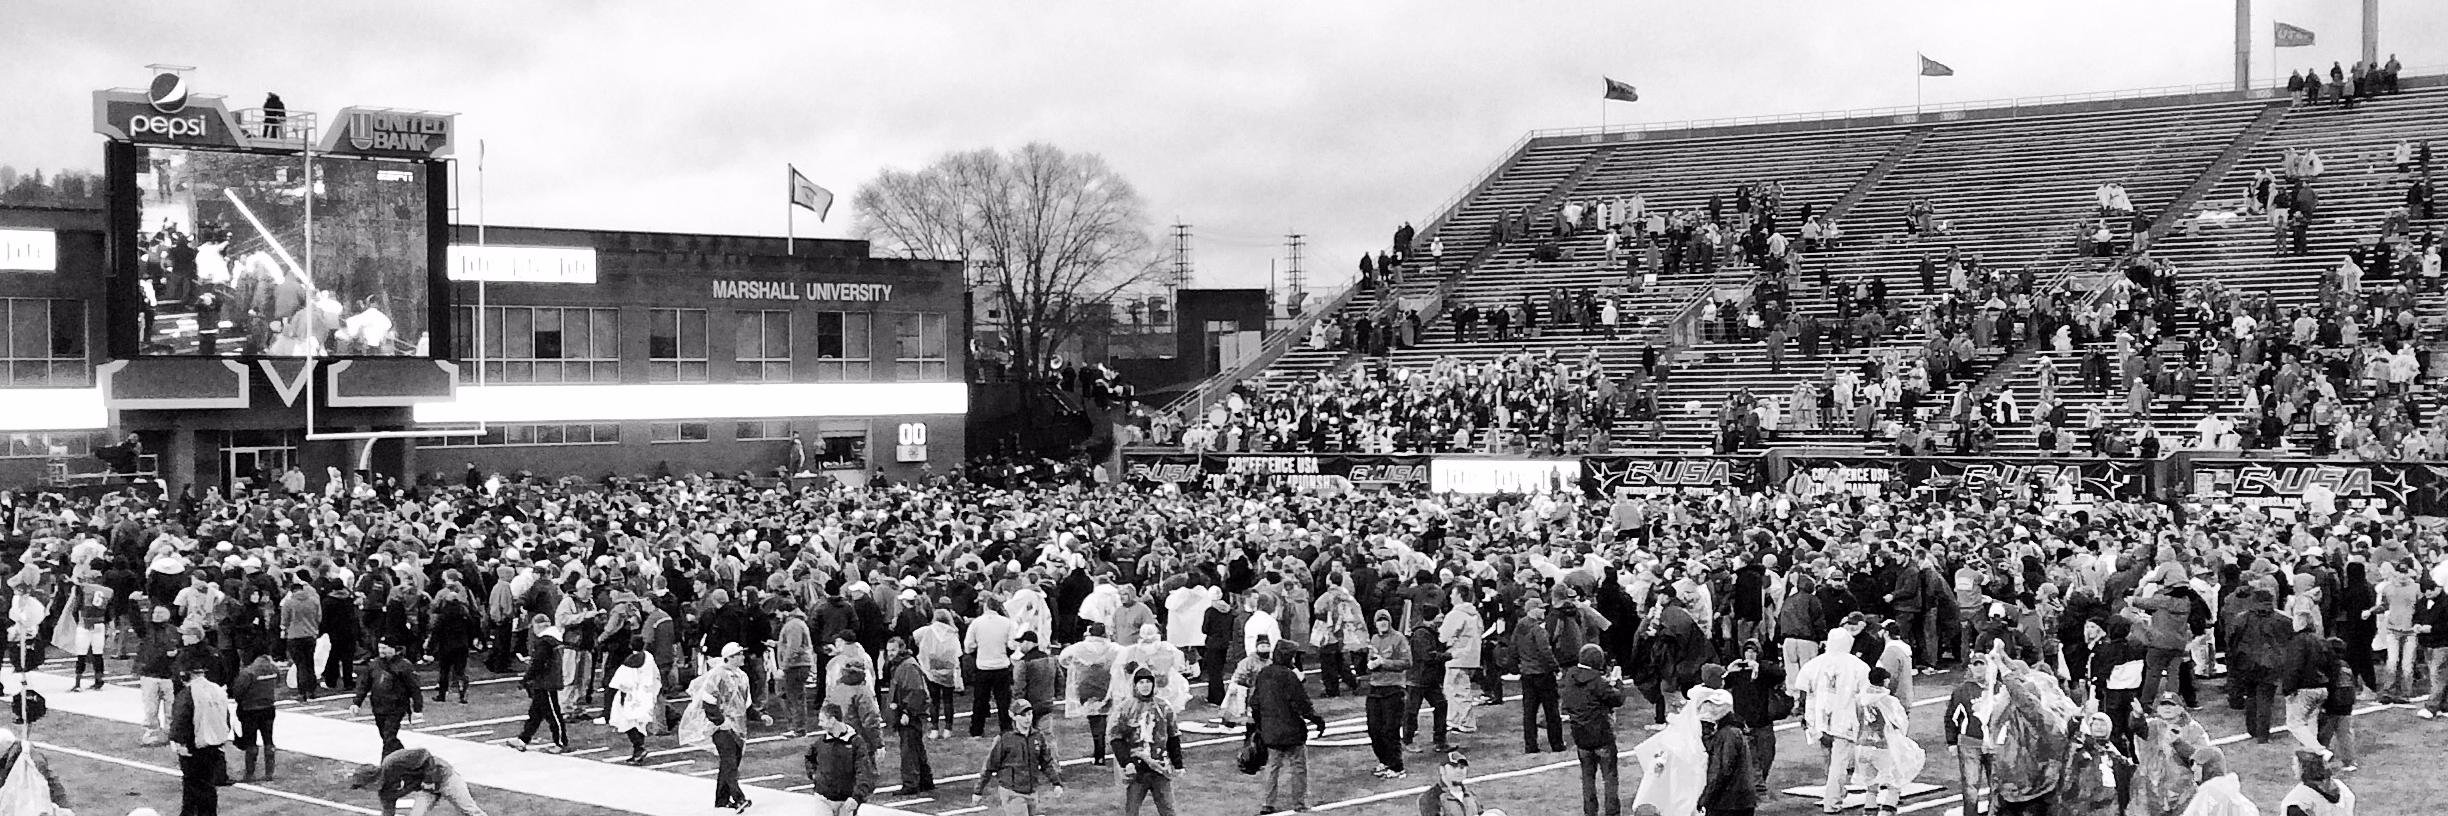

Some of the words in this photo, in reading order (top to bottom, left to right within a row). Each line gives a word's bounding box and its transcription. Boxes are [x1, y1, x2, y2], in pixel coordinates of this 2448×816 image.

[129, 114, 206, 140] pepsi
[373, 113, 447, 134] UNITED
[373, 131, 430, 152] BANK
[712, 280, 800, 300] MARSHALL
[806, 282, 893, 301] UNIVERSITY
[1297, 456, 1320, 474] USA
[1870, 468, 1890, 482] USA
